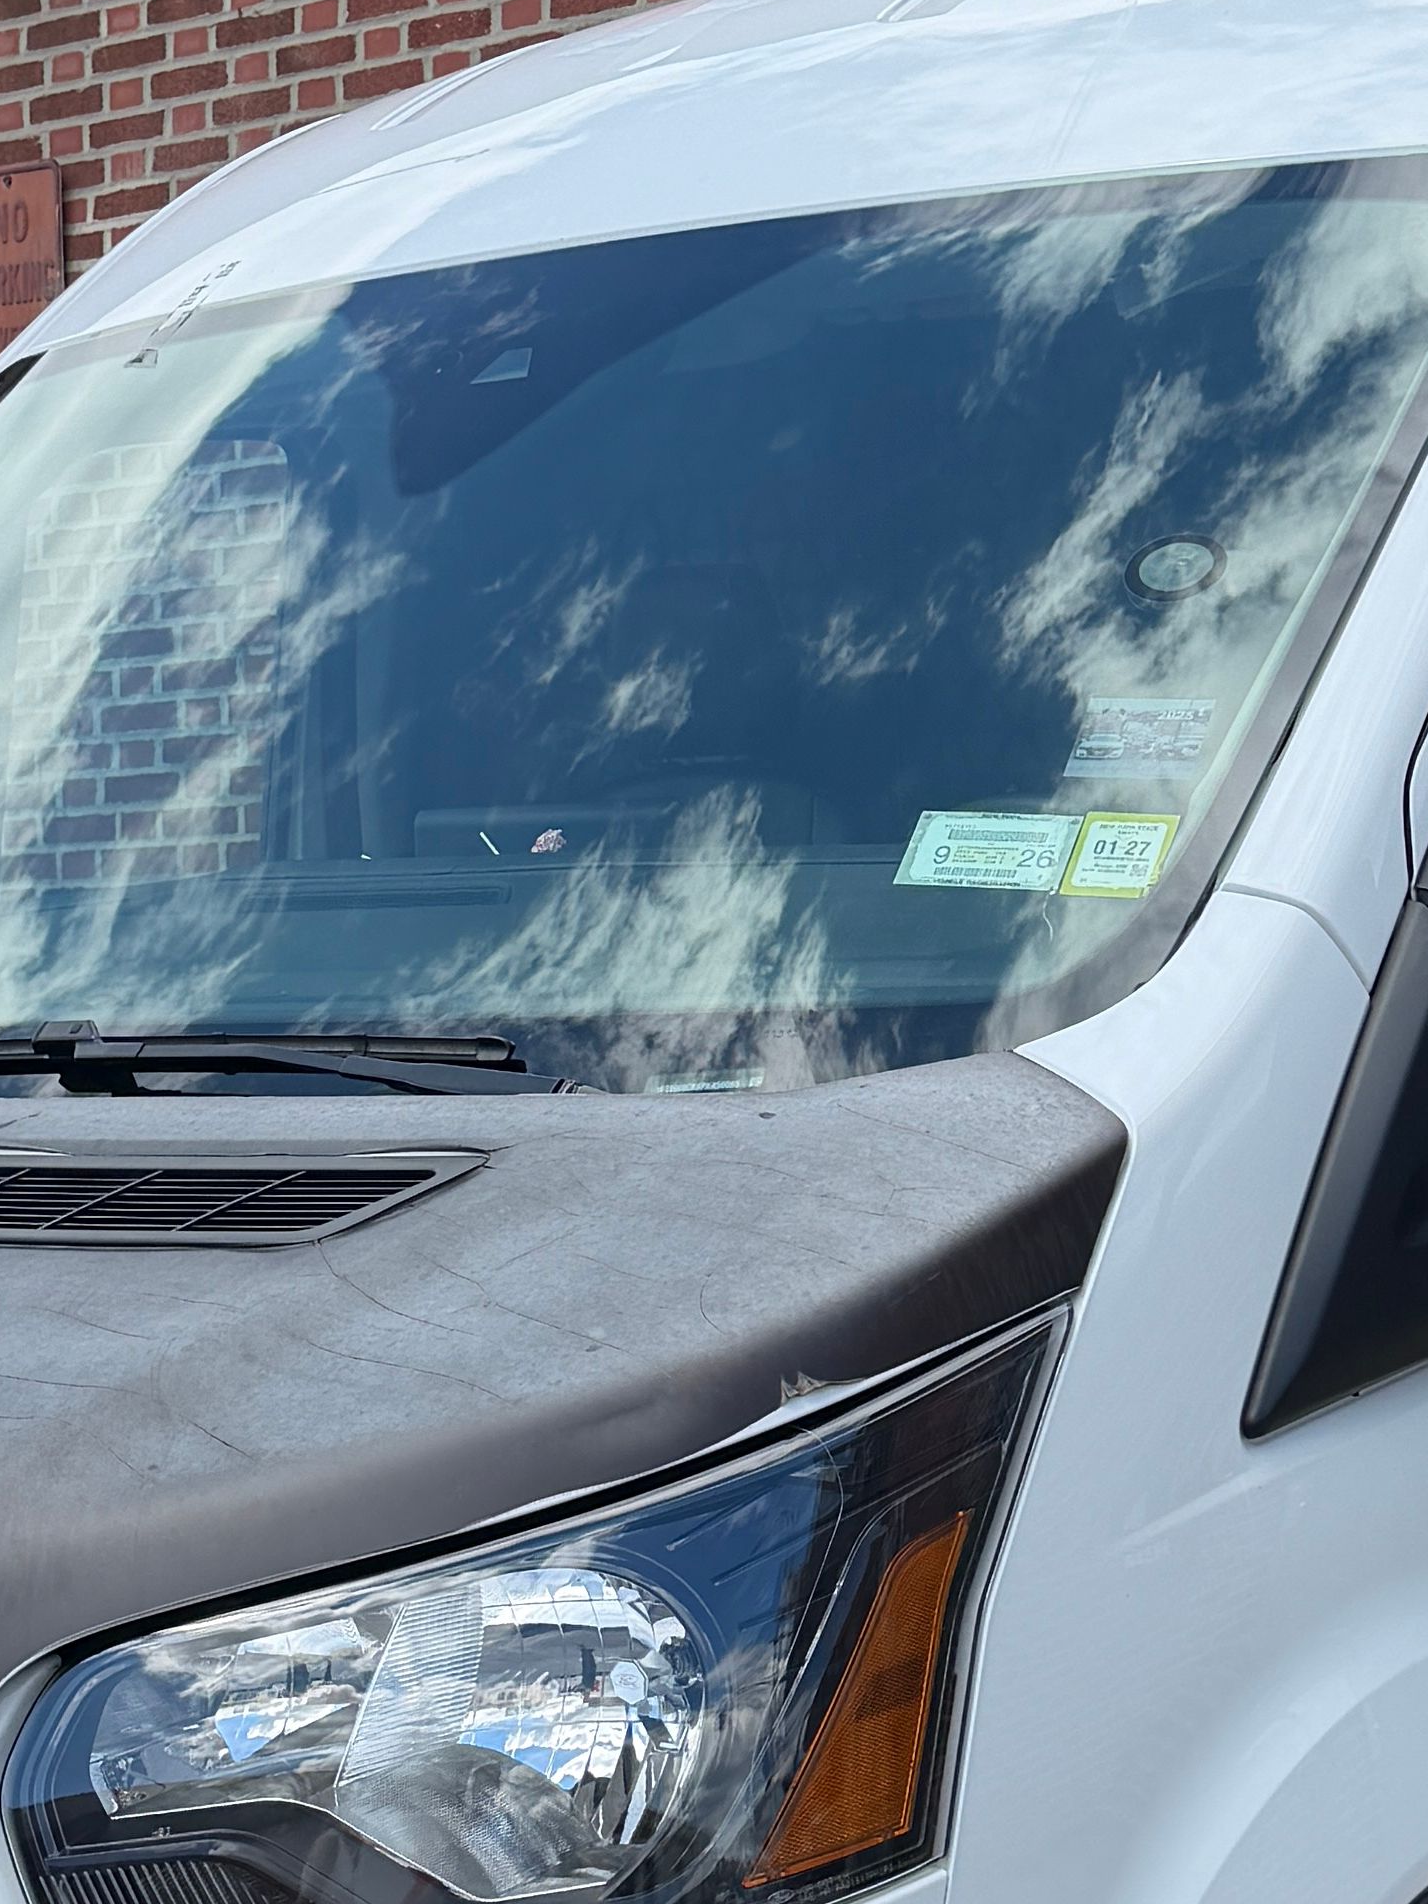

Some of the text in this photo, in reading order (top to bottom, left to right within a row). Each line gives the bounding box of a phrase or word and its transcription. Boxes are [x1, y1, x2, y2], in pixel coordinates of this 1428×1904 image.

[933, 845, 951, 865] 9
[1016, 849, 1056, 869] 26
[1093, 839, 1152, 856] 01 27
